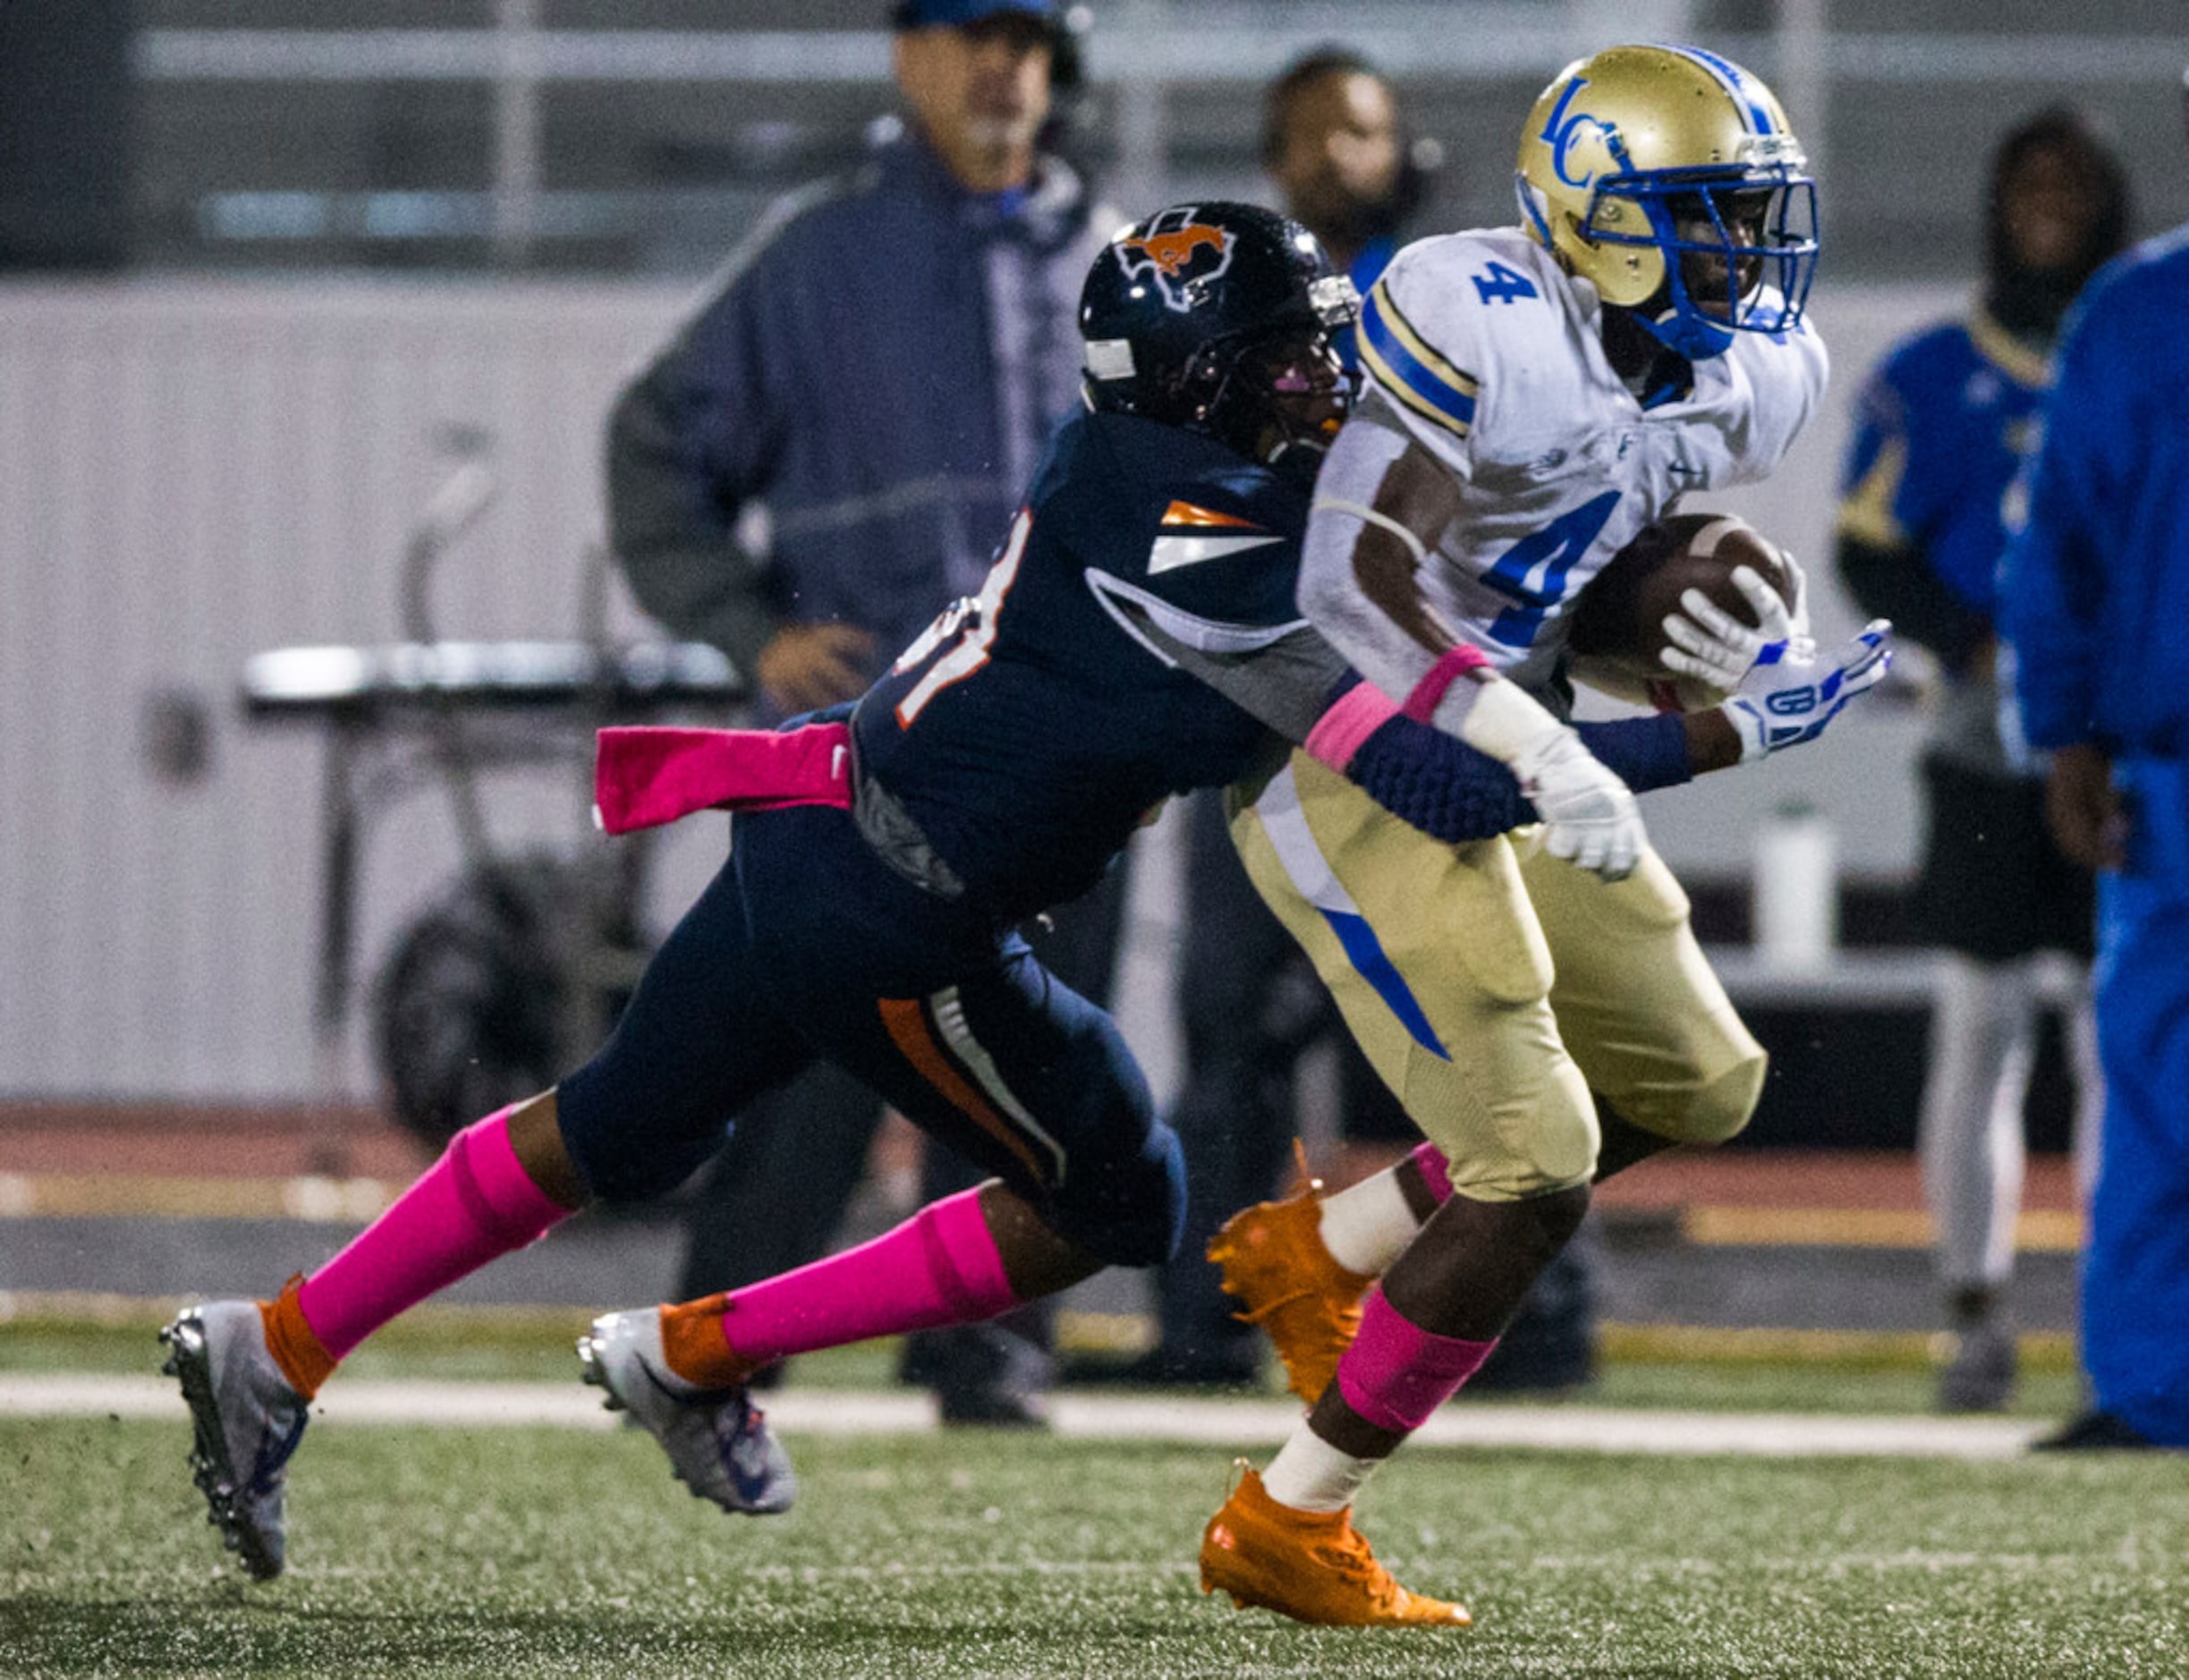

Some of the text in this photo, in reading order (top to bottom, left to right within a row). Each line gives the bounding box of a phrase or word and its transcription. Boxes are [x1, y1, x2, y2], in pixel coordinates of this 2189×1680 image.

[1539, 75, 1598, 189] LC
[1471, 260, 1539, 305] 4
[1479, 489, 1623, 649] 4
